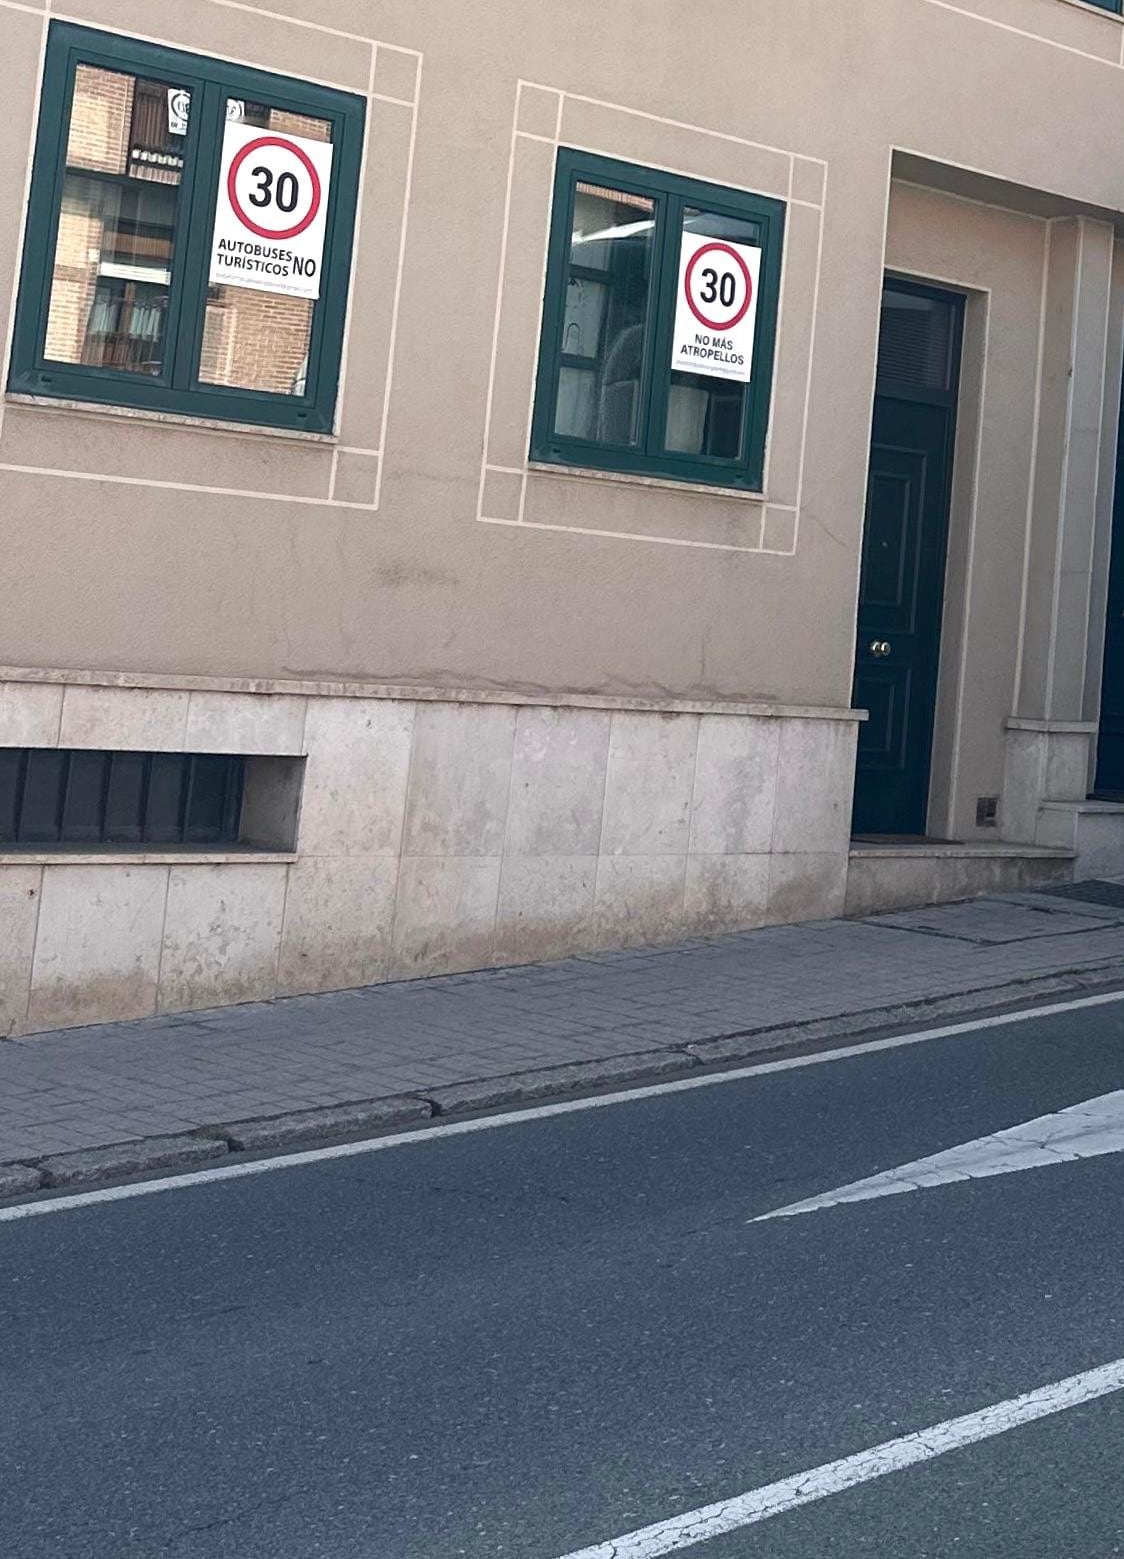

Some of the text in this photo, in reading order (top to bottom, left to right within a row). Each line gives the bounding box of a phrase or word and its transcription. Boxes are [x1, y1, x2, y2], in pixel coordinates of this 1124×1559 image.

[248, 165, 299, 213] 30
[218, 238, 293, 262] AUTOBUSES
[216, 252, 289, 277] TURÍSTICOS
[292, 255, 316, 278] NO
[699, 267, 736, 308] 30
[694, 333, 733, 351] NO MÁS
[680, 344, 745, 366] ATROPELLOS
